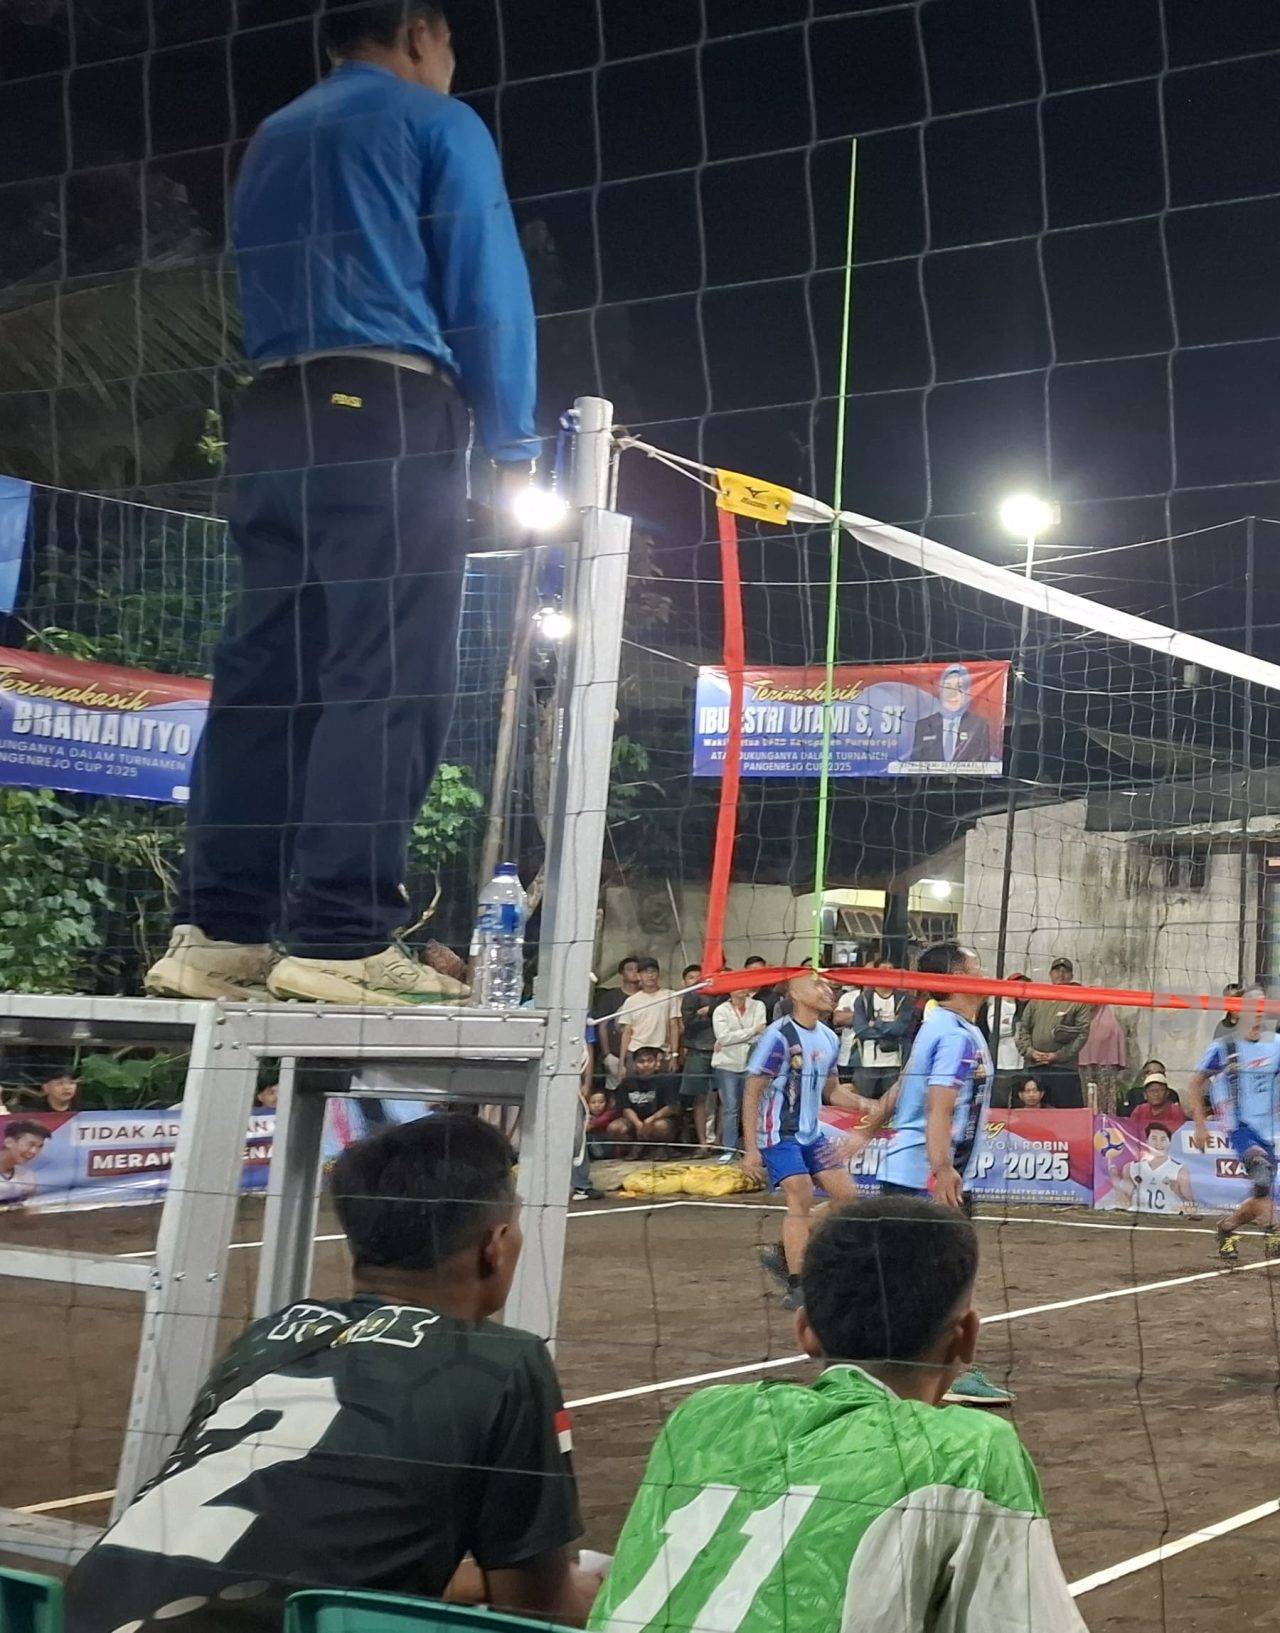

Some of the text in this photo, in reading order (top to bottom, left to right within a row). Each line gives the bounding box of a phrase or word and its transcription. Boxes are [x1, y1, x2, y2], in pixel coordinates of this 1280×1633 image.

[0, 665, 150, 711] Terimakasih
[750, 679, 865, 703] Terimaksih
[12, 700, 192, 755] BRAMANTYO
[698, 706, 730, 734] IBU
[741, 706, 785, 734] STRI
[68, 747, 115, 762] DALAM
[119, 752, 186, 771] TURNAMEN
[74, 760, 101, 773] CUP
[105, 764, 138, 777] 2025
[743, 761, 803, 772] PANGENREJO
[79, 1125, 146, 1140] TIDAK
[1022, 1141, 1069, 1151] ROBIN
[1003, 1152, 1070, 1181] 2025
[98, 1373, 342, 1563] 2
[604, 1483, 823, 1633] 11
